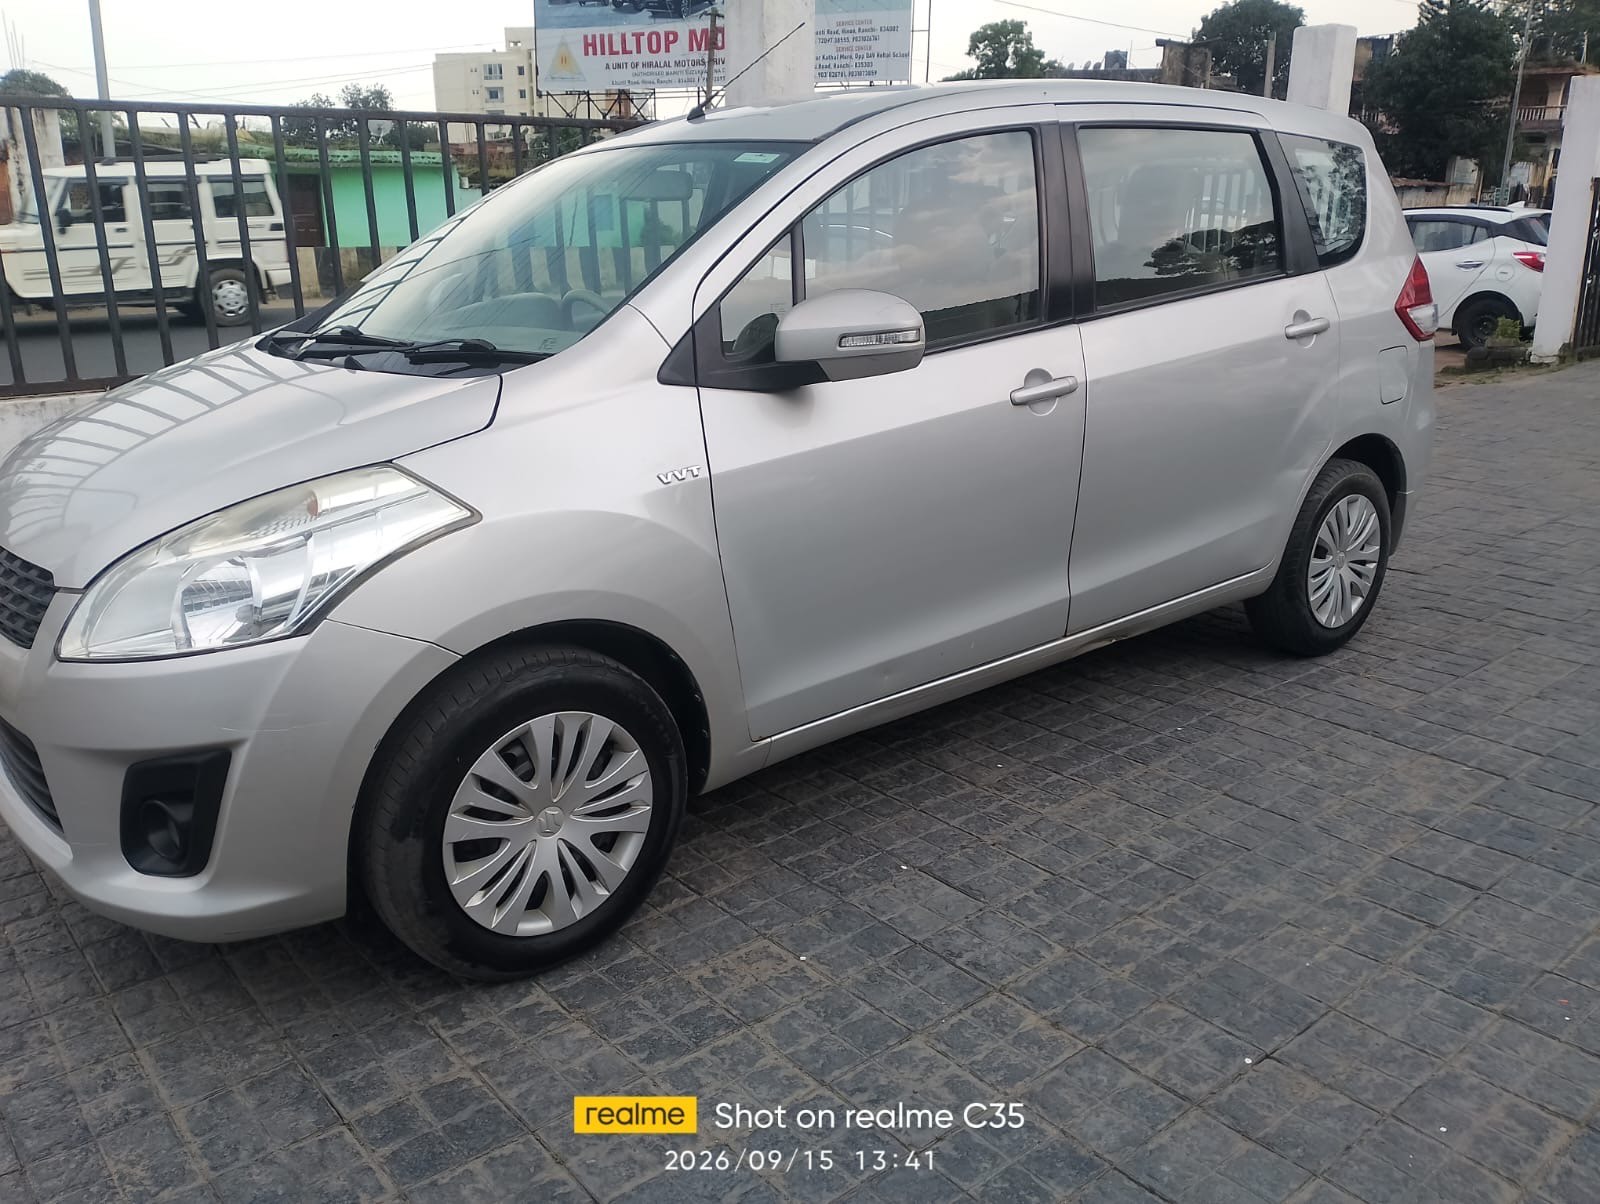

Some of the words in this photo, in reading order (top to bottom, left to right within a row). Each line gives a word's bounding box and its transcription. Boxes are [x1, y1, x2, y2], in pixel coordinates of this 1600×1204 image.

[583, 29, 679, 57] HILLTOP
[605, 62, 610, 70] A
[612, 61, 628, 70] UNIT
[630, 61, 640, 69] OF
[642, 60, 672, 69] HIRALAL
[674, 58, 706, 68] MOTORS
[657, 465, 701, 485] VVT
